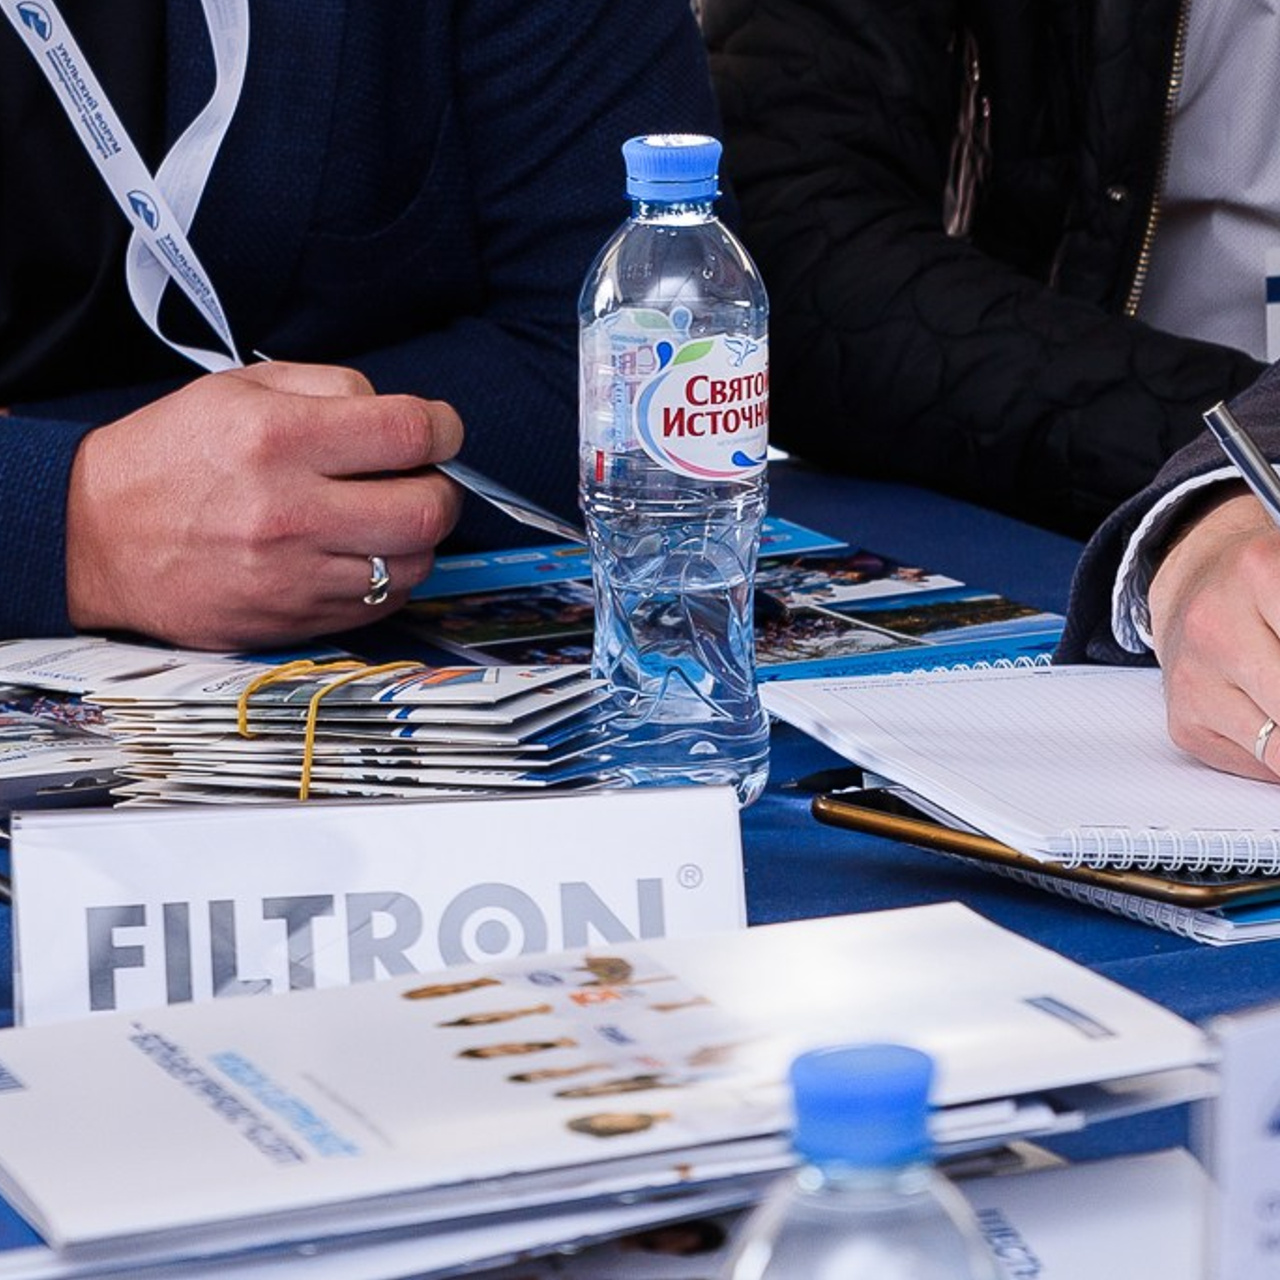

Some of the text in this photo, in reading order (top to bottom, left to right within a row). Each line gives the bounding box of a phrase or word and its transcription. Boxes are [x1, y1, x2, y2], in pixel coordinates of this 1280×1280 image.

[54, 42, 99, 111] УРАЛЬСКИЙ
[94, 108, 122, 154] ФОРУМ
[163, 233, 214, 297] УРАЛЬСКИЙ
